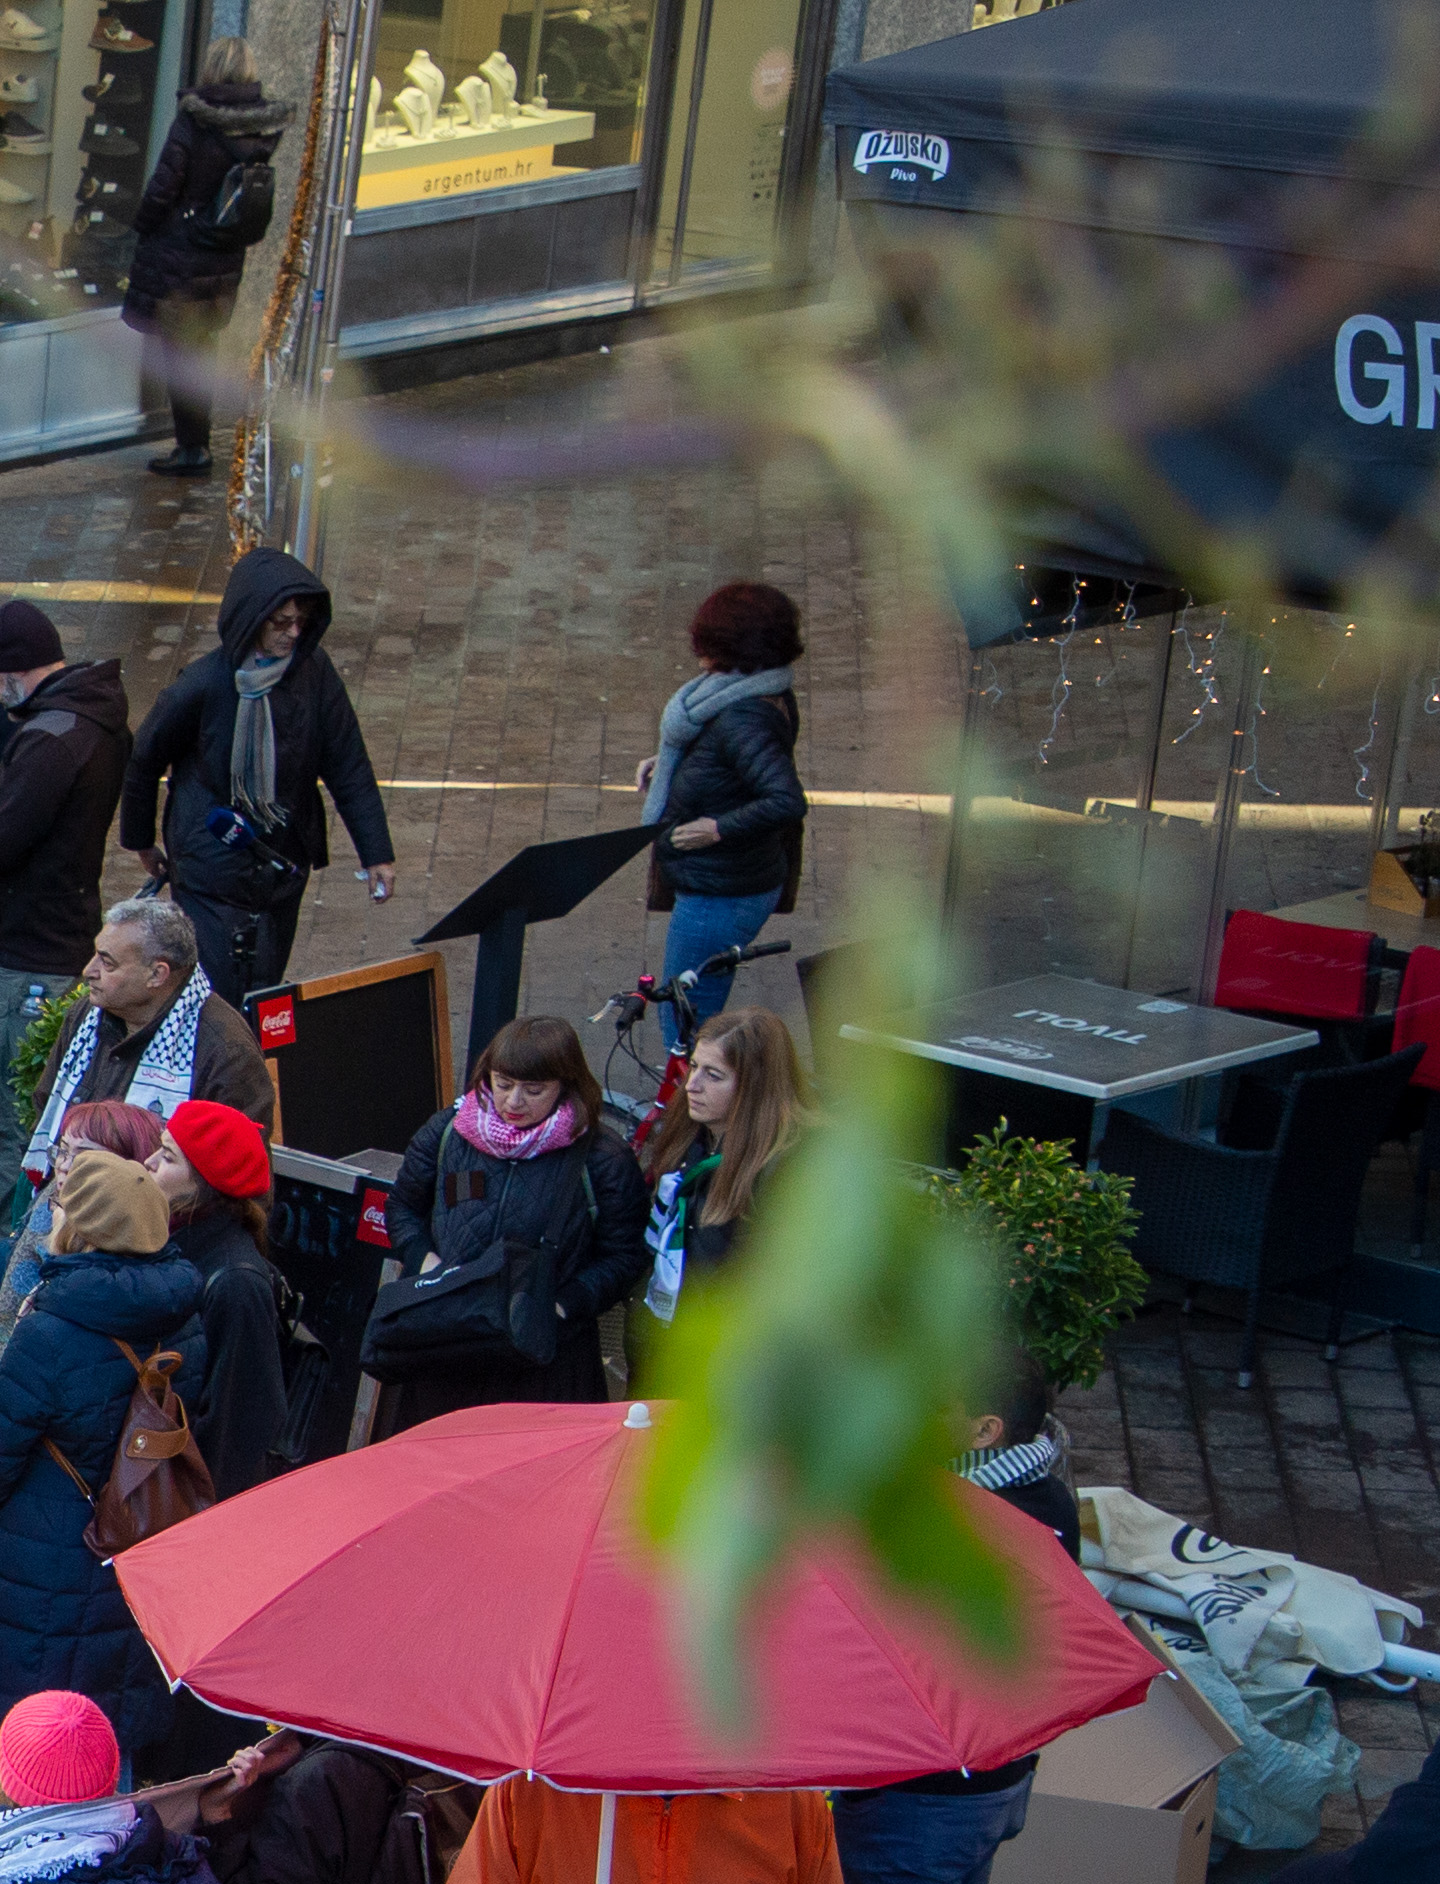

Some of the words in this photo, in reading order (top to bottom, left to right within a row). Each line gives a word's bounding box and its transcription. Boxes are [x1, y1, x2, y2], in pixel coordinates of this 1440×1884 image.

[423, 160, 534, 194] argentum.hr
[890, 168, 917, 182] Pivo
[1012, 1009, 1148, 1045] TIVOLI
